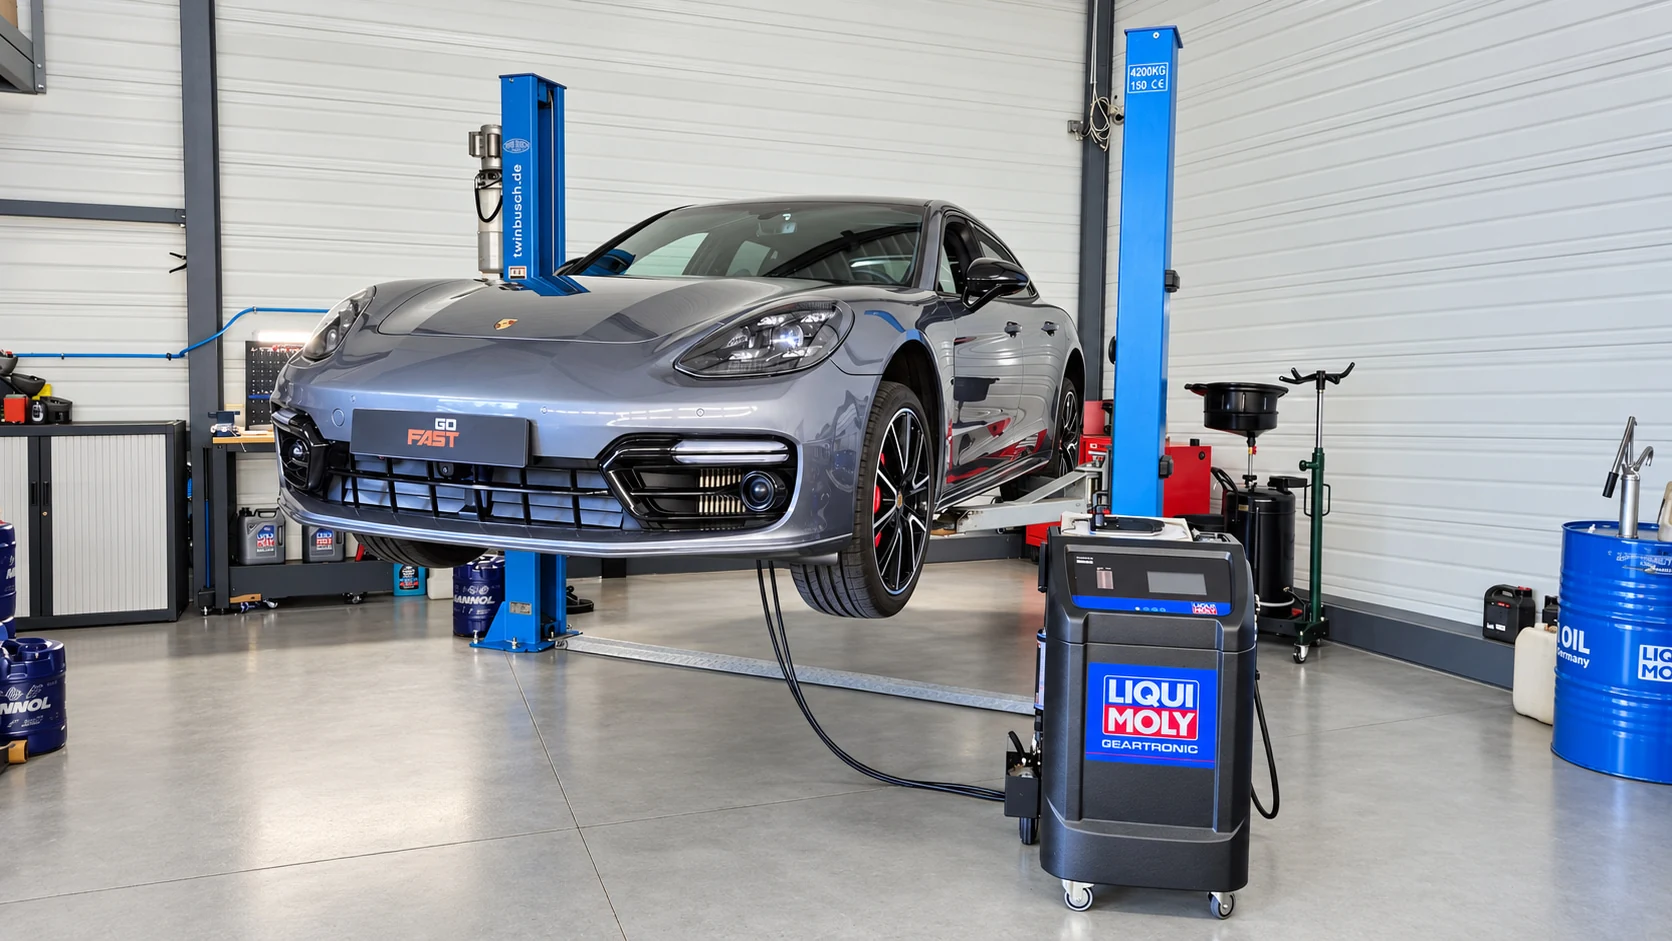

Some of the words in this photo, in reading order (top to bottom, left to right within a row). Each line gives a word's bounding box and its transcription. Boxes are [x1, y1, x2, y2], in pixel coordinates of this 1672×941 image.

[1130, 65, 1166, 77] 4200KG
[1130, 80, 1147, 90] 150
[512, 164, 522, 258] twinbusch.de
[434, 417, 457, 431] GO
[407, 428, 460, 448] FAST
[1561, 625, 1591, 655] OIL
[1108, 679, 1194, 708] LIQUI
[1107, 707, 1196, 737] MOLY
[1101, 739, 1198, 755] GEARTRONIC
